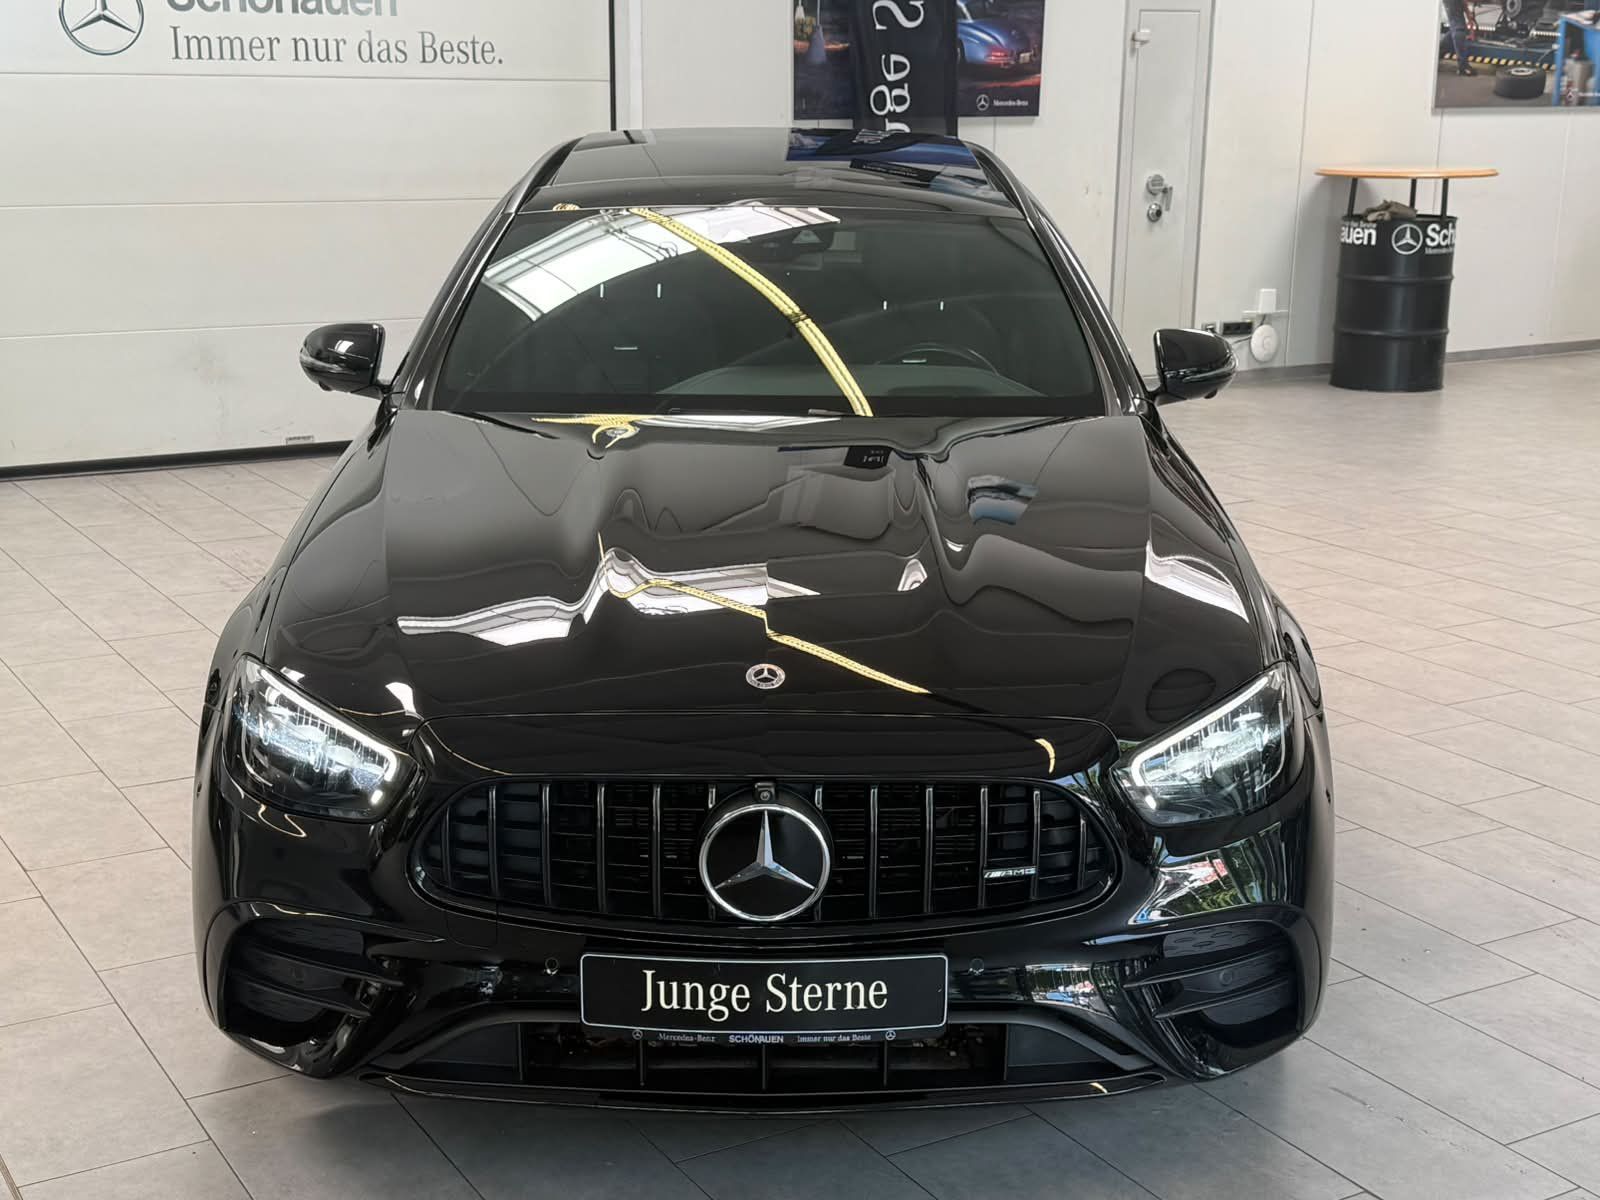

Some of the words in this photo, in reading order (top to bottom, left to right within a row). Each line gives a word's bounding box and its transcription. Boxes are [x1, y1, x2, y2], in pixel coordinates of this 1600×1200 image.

[169, 25, 281, 62] Immer
[291, 36, 347, 63] nur
[357, 30, 408, 64] das
[418, 31, 503, 65] Beste.
[641, 969, 751, 1023] Junge
[765, 972, 889, 1013] Sterne
